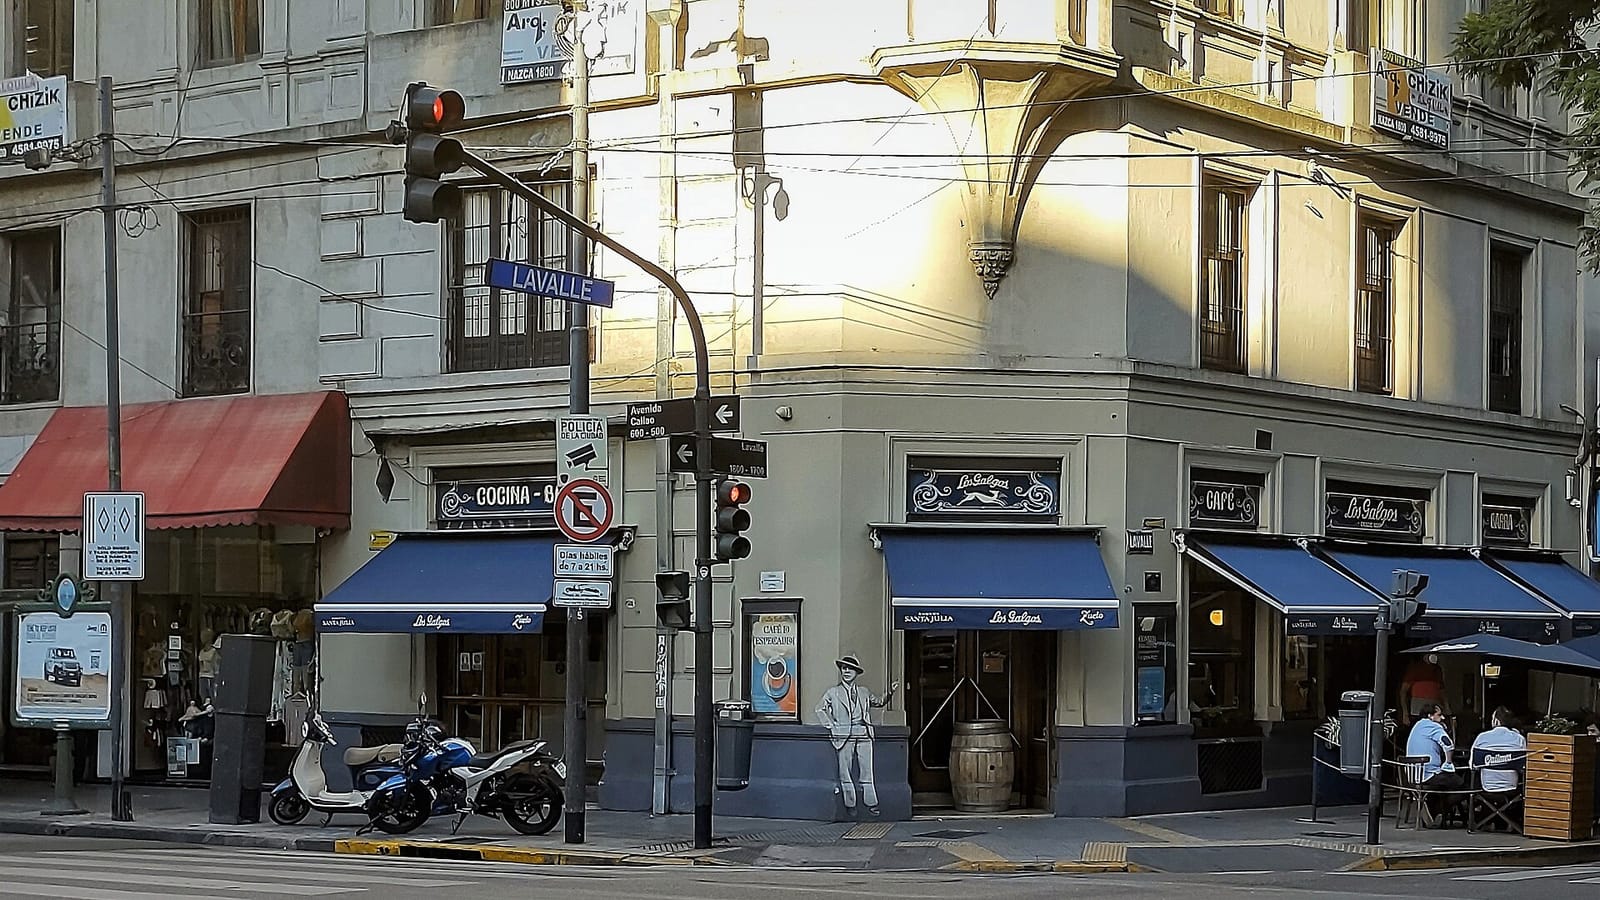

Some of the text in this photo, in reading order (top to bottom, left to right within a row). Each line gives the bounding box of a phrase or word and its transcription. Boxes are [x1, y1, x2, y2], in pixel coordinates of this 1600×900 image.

[508, 66, 553, 80] NAZCA 1800
[1396, 101, 1435, 126] VENDE
[0, 124, 42, 140] ENDE
[512, 265, 593, 301] LAVALLE
[630, 403, 662, 416] Avenida
[630, 416, 655, 426] Callao
[741, 441, 765, 453] Lavalle
[957, 473, 1010, 490] Los Galgos
[476, 485, 531, 506] COCINA
[1206, 487, 1235, 511] CAFÉ
[1344, 497, 1398, 529] Los Galgos
[1129, 534, 1152, 548] LAVALLE
[559, 560, 569, 570] de
[571, 562, 576, 571] 7
[584, 562, 594, 572] 21
[413, 614, 450, 629] Los Galgos
[576, 610, 583, 620] 5
[990, 610, 1042, 626] Los Galgos
